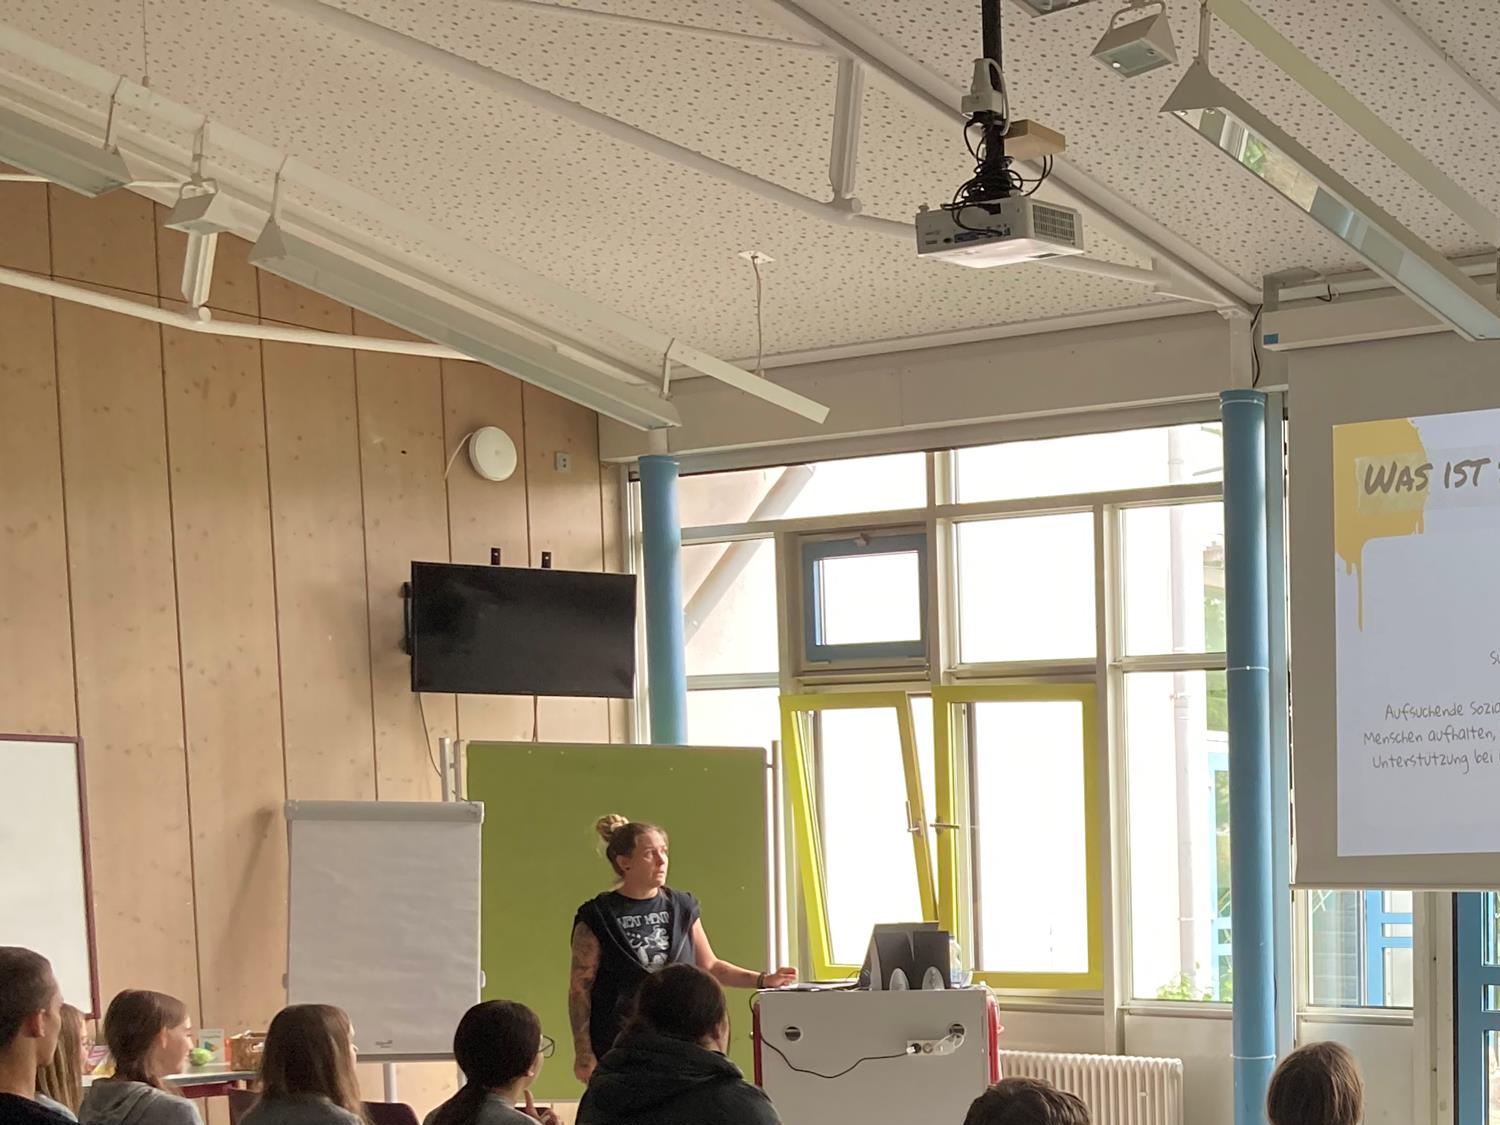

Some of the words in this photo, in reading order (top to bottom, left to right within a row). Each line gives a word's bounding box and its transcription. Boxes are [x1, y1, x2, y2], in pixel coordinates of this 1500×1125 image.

[1364, 461, 1432, 495] WAS
[1444, 458, 1490, 488] IST
[1385, 703, 1464, 721] Aufsuchende
[1364, 731, 1422, 745] Menschen
[1428, 725, 1496, 743] aufhalten,
[1474, 748, 1493, 764] bei
